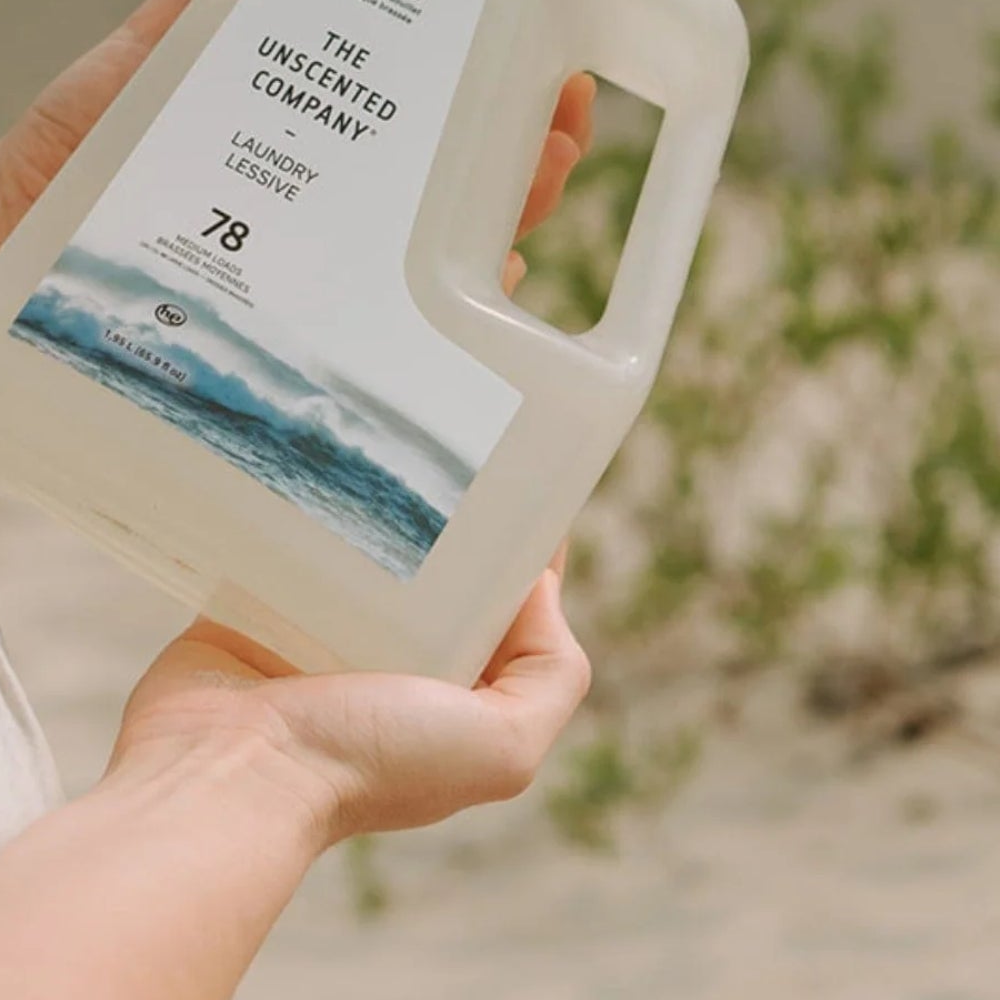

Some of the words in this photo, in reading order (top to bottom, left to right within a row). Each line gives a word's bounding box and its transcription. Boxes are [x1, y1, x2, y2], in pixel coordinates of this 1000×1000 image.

[321, 31, 370, 69] THE
[258, 36, 397, 121] UNSCENTED
[225, 152, 300, 202] LESSIVE
[231, 131, 319, 185] LAUNDRY
[200, 207, 250, 252] 78
